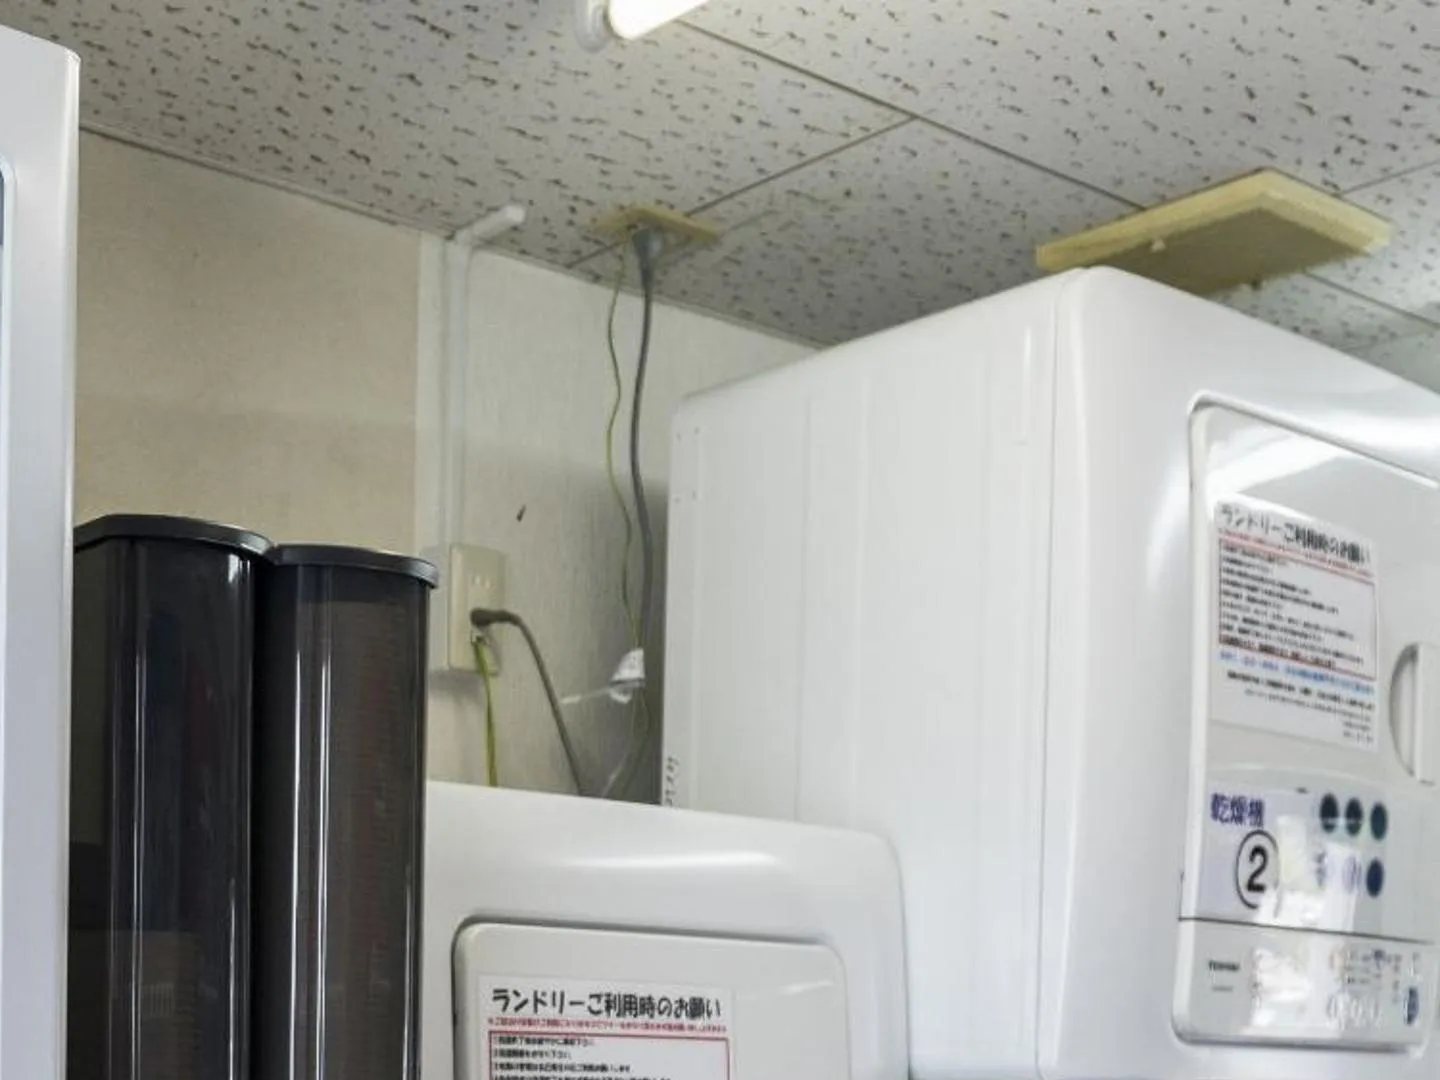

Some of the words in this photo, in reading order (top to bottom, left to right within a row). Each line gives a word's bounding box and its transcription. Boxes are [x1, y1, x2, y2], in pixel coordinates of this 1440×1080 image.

[491, 988, 722, 1020] ランドリーご利用時のお願い
